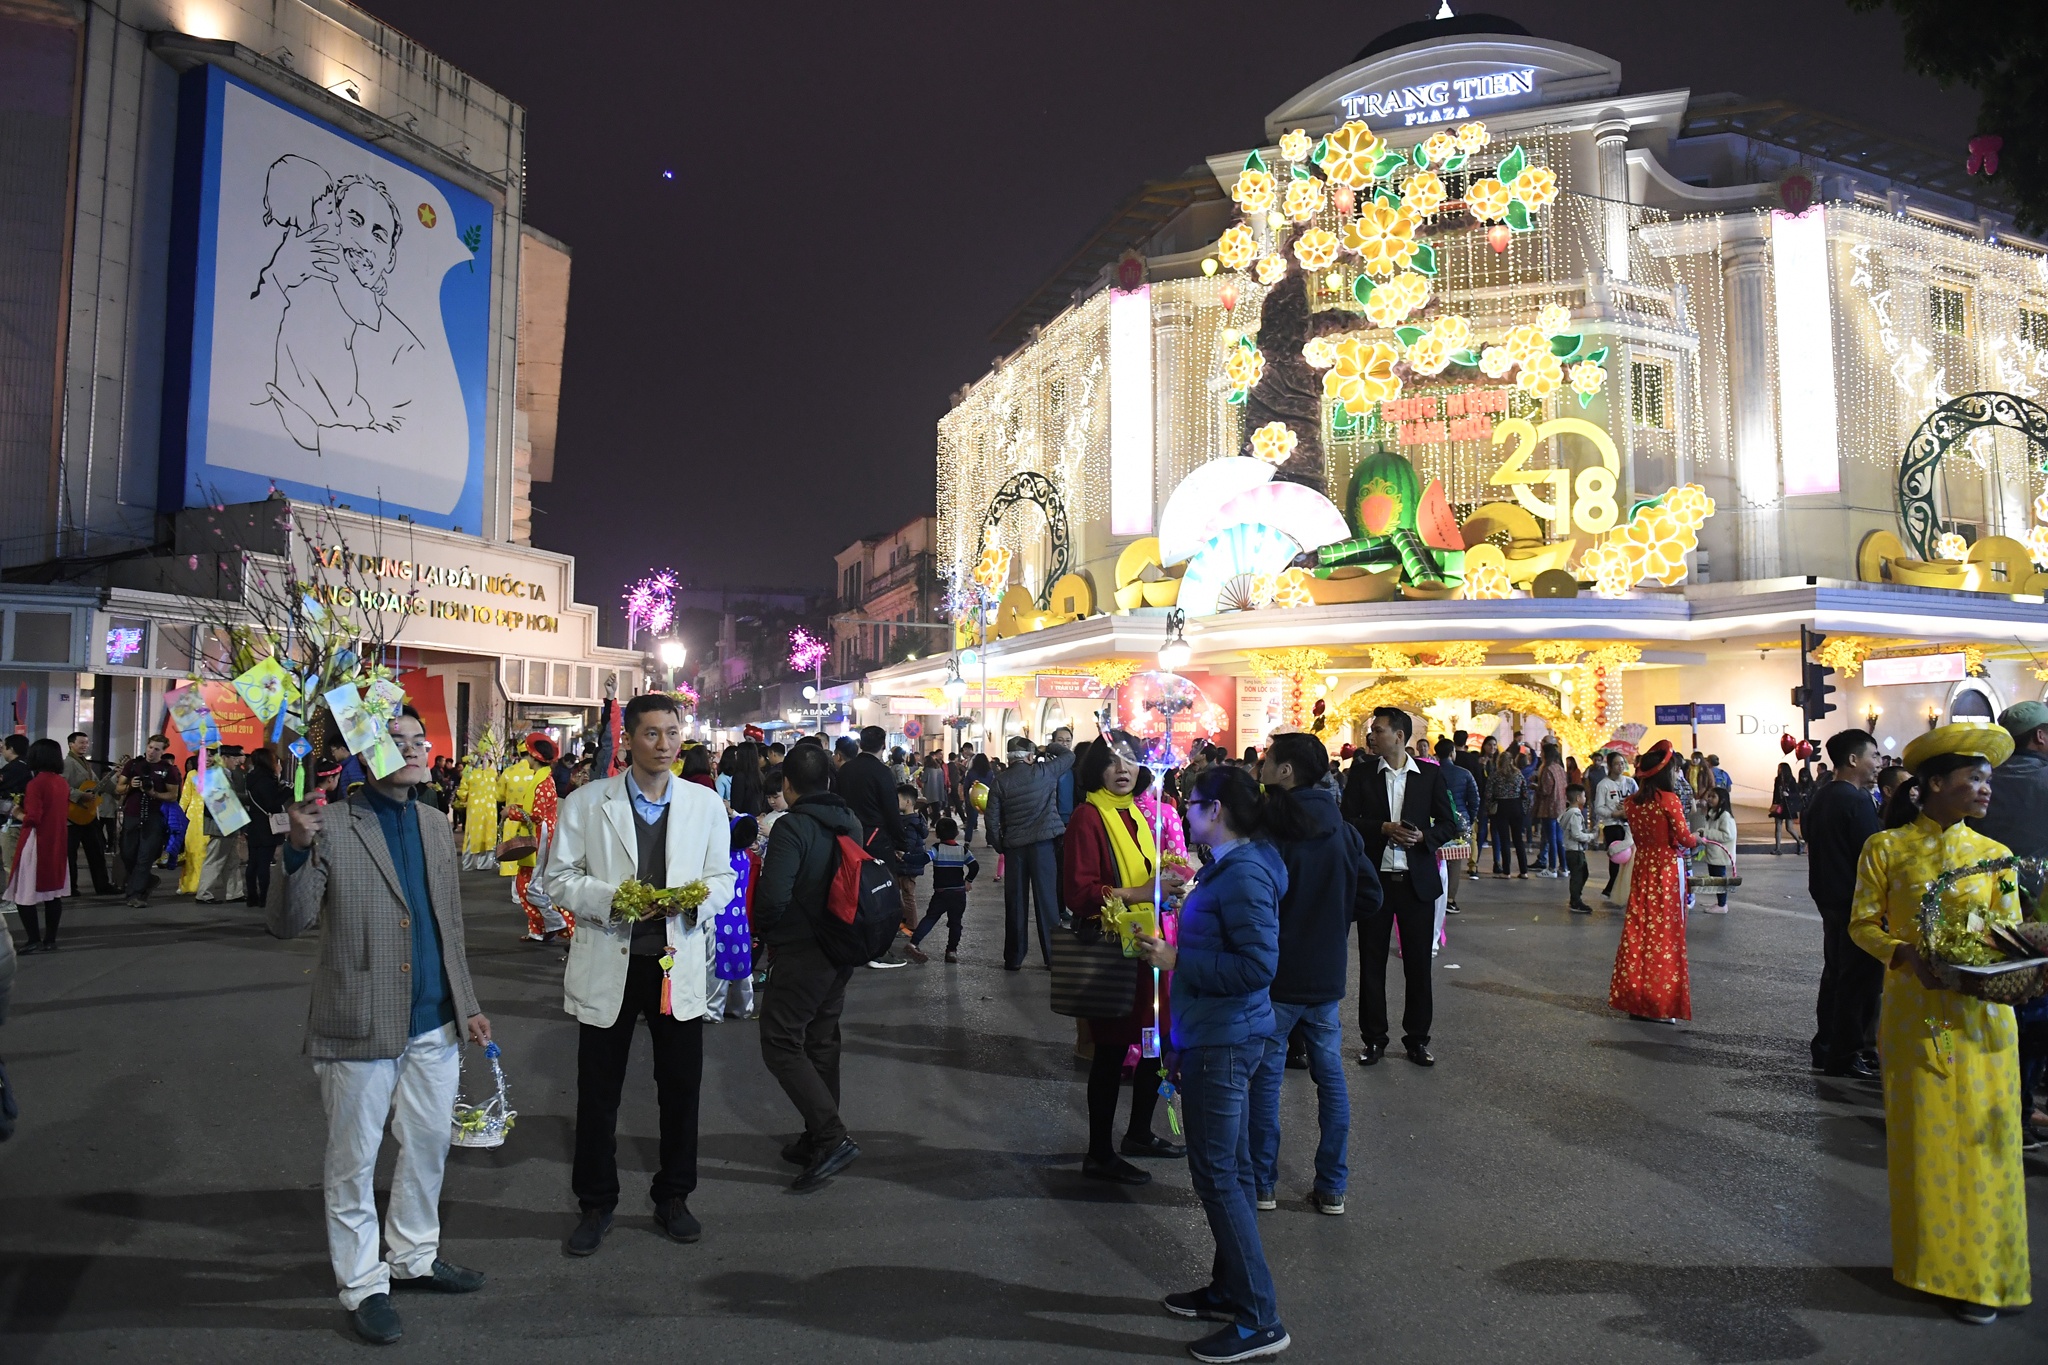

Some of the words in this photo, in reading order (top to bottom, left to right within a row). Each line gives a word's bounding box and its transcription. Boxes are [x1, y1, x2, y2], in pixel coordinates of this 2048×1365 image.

[1341, 81, 1449, 119] TRANG
[1453, 69, 1534, 103] TIEN
[1405, 105, 1470, 126] PLAZA
[528, 582, 547, 602] TA
[472, 604, 494, 625] TO
[1736, 714, 1789, 735] Dior
